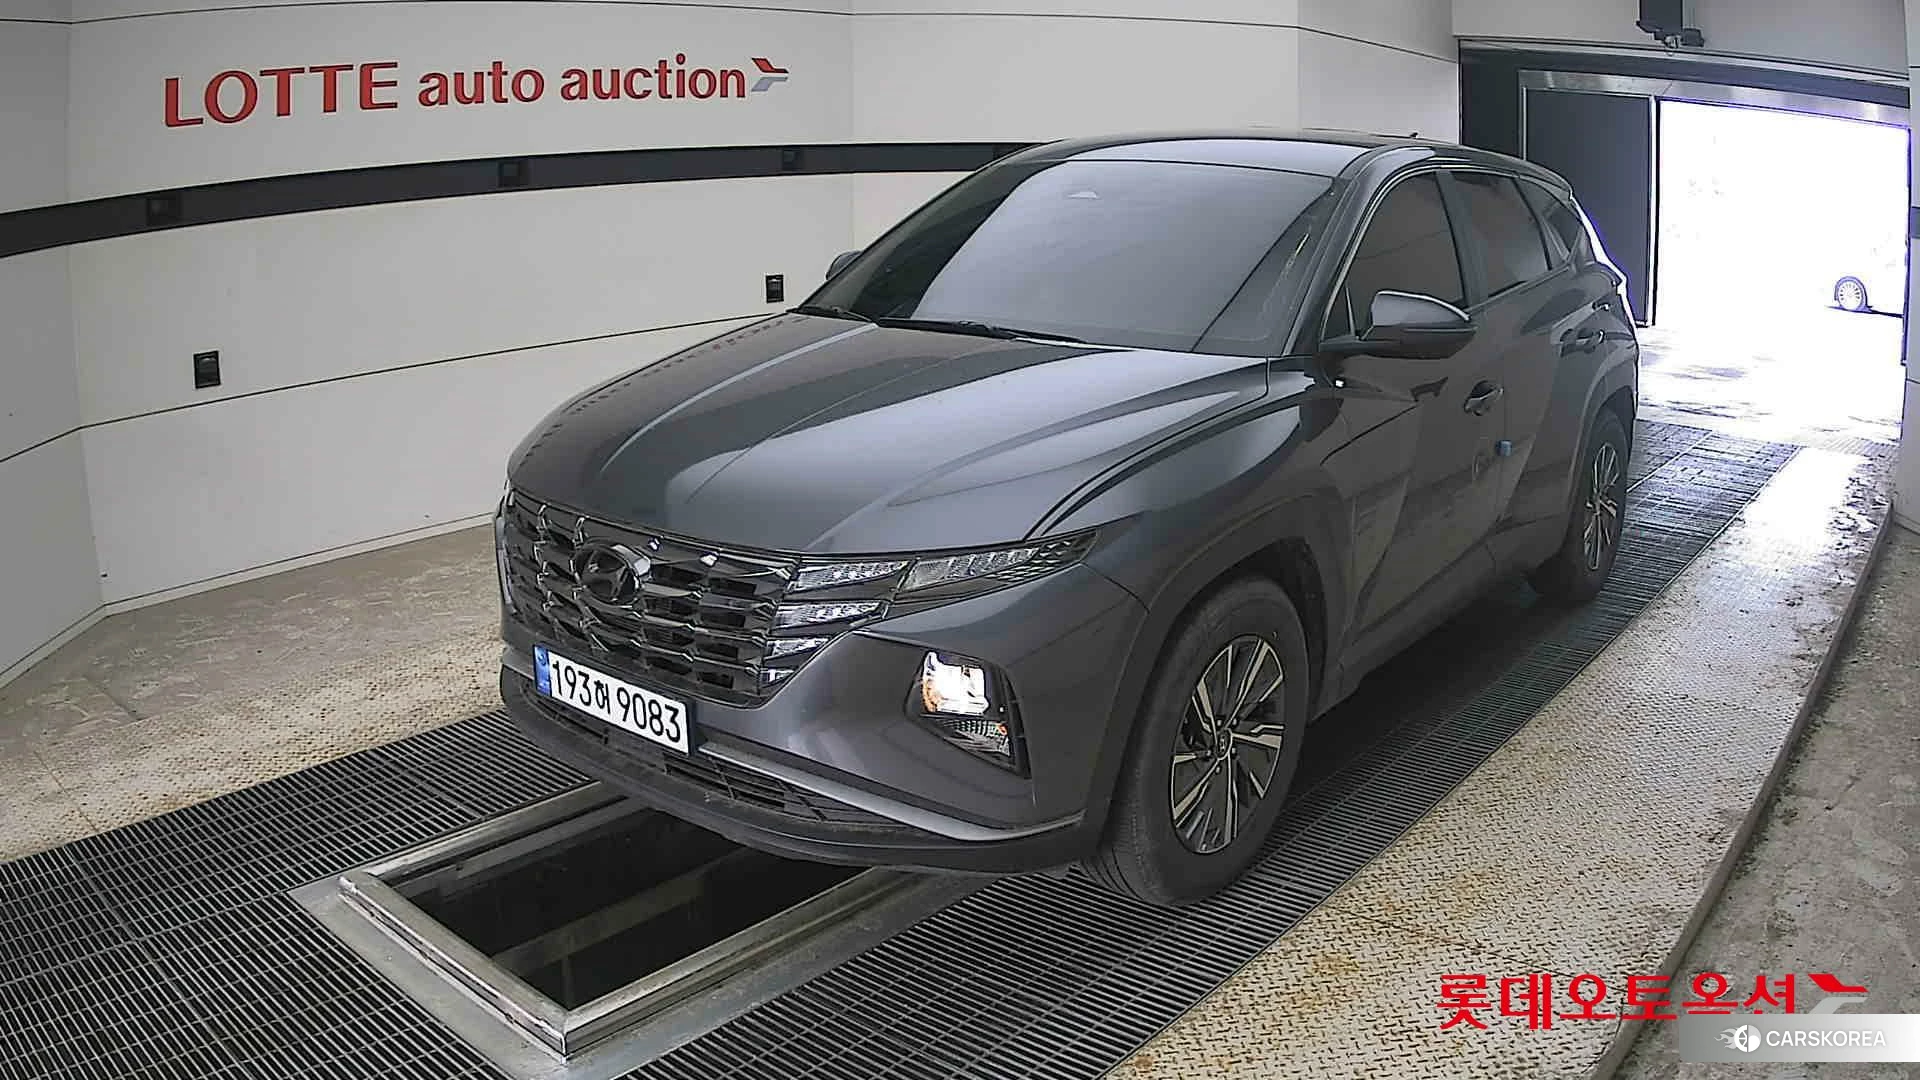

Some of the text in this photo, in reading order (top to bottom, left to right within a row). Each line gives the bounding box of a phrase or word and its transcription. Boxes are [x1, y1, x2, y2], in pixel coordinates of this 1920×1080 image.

[164, 52, 746, 127] LOTTE auto auction
[616, 686, 681, 743] 9083
